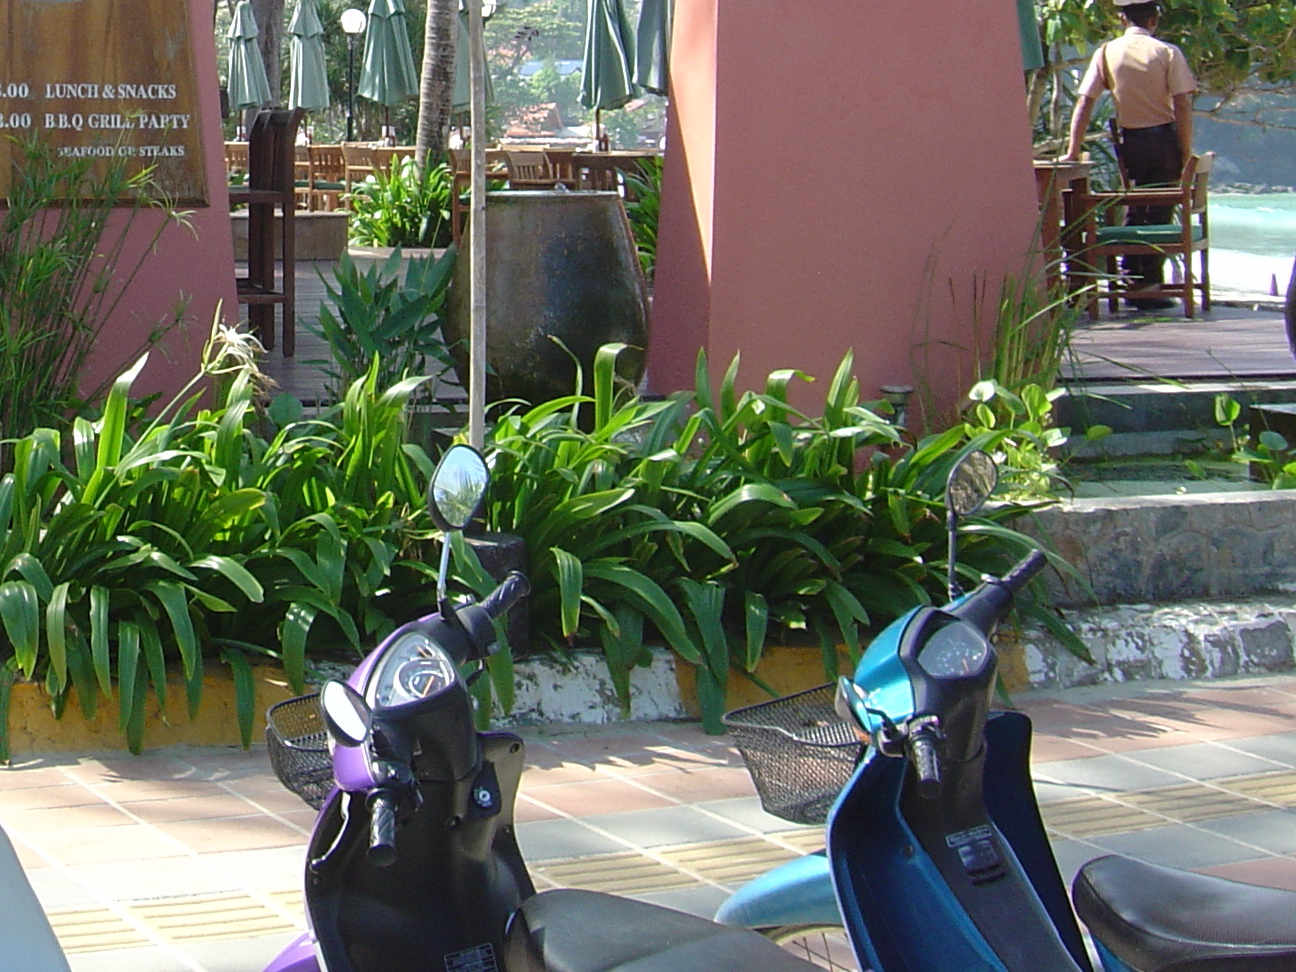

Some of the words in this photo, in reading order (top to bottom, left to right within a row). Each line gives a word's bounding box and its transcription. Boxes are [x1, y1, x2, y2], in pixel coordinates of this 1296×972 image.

[45, 84, 99, 99] LUNCH
[102, 85, 115, 99] &
[117, 84, 177, 100] SNACKS
[138, 114, 191, 130] PARTY
[138, 145, 185, 157] STEAKS
